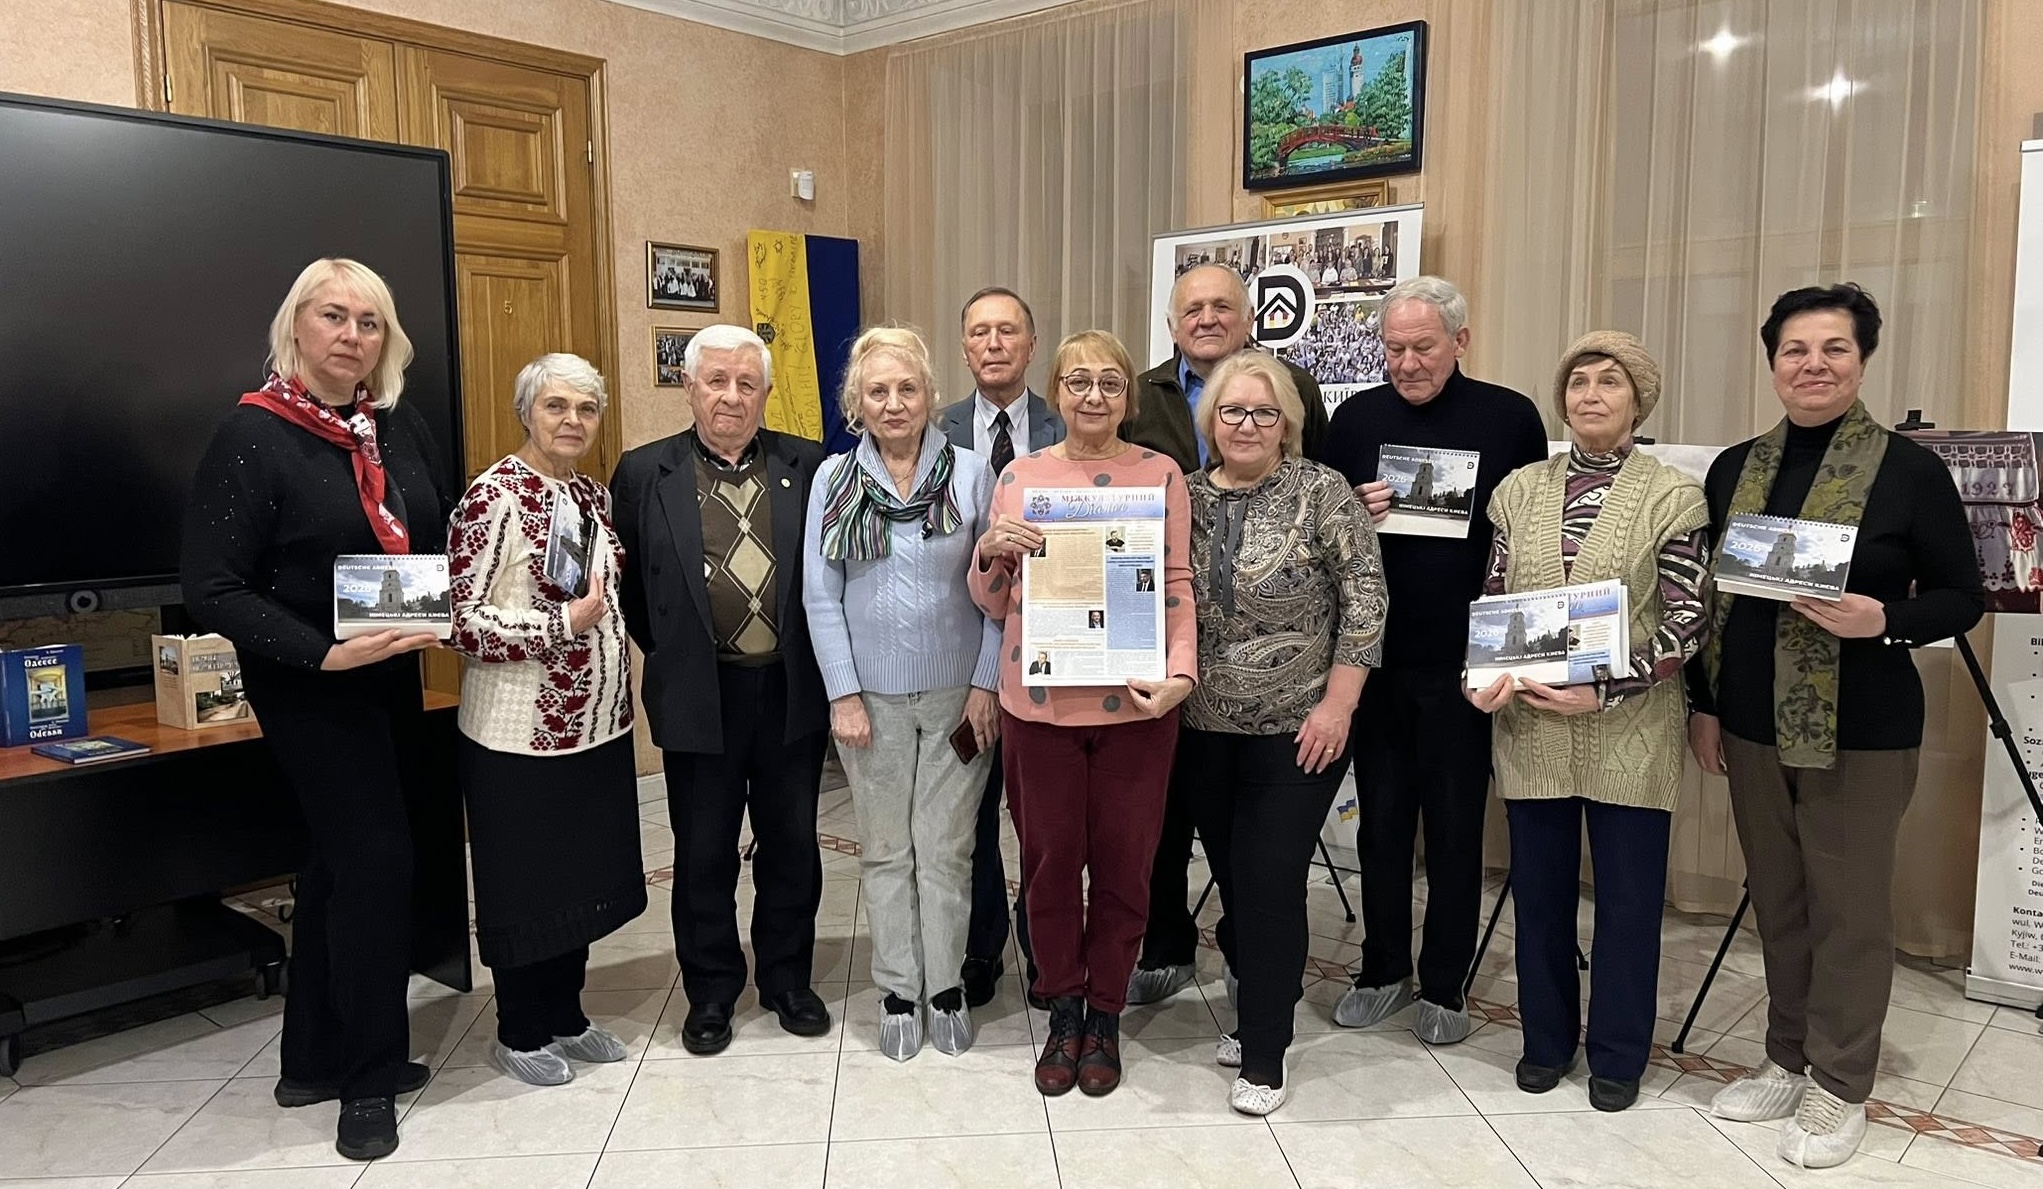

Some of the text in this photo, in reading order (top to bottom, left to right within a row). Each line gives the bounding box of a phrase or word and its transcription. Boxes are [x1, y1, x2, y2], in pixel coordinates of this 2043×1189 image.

[503, 300, 513, 315] 5
[1382, 474, 1407, 483] 2026
[1731, 541, 1761, 552] 2026
[343, 585, 372, 593] 2026
[1474, 628, 1499, 638] 2026
[30, 730, 63, 738] Odessa
